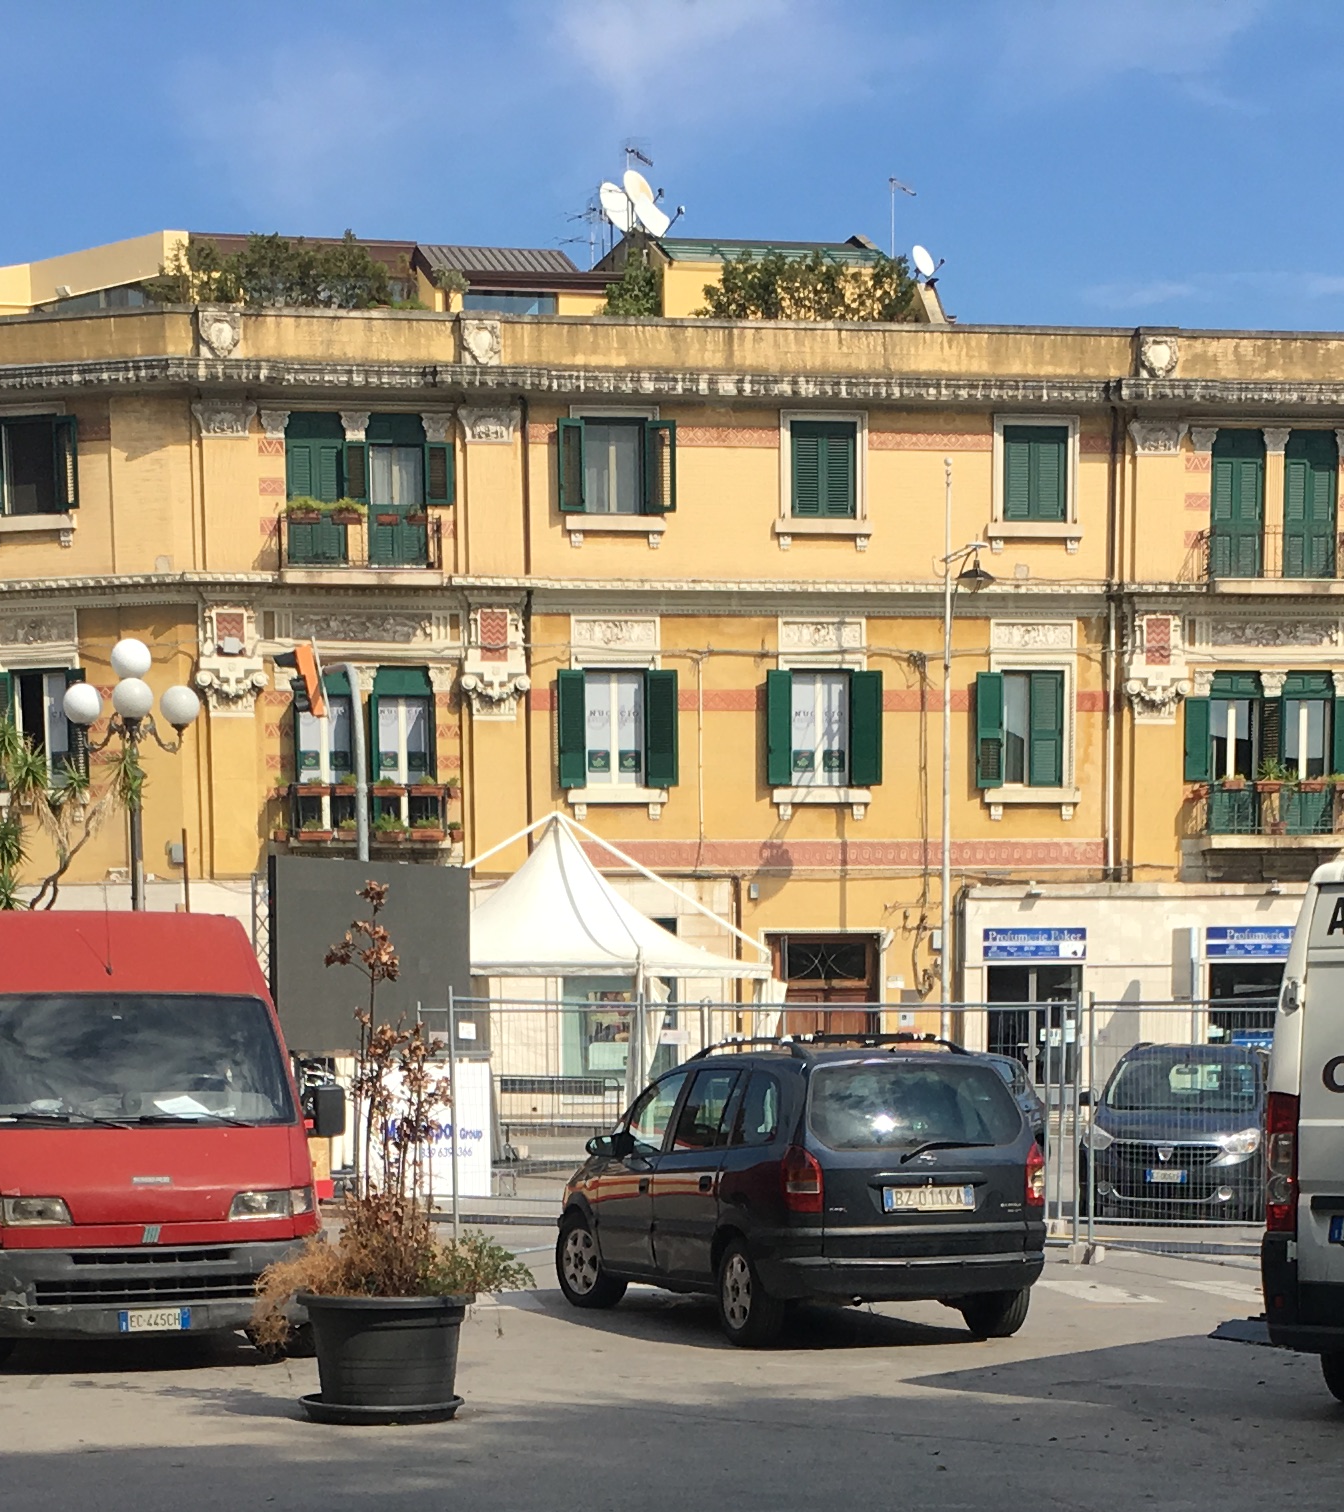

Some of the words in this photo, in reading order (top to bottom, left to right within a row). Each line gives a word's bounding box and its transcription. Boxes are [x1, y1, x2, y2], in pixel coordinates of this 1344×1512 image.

[988, 930, 1048, 942] Profumerie
[1051, 930, 1082, 941] Poker
[1226, 929, 1285, 941] Profumerie
[459, 1127, 483, 1141] Group
[438, 1146, 473, 1158] 639366
[895, 1190, 914, 1206] BZ
[918, 1189, 964, 1206] 011KA
[129, 1314, 144, 1328] EC
[146, 1313, 181, 1327] 445CH
